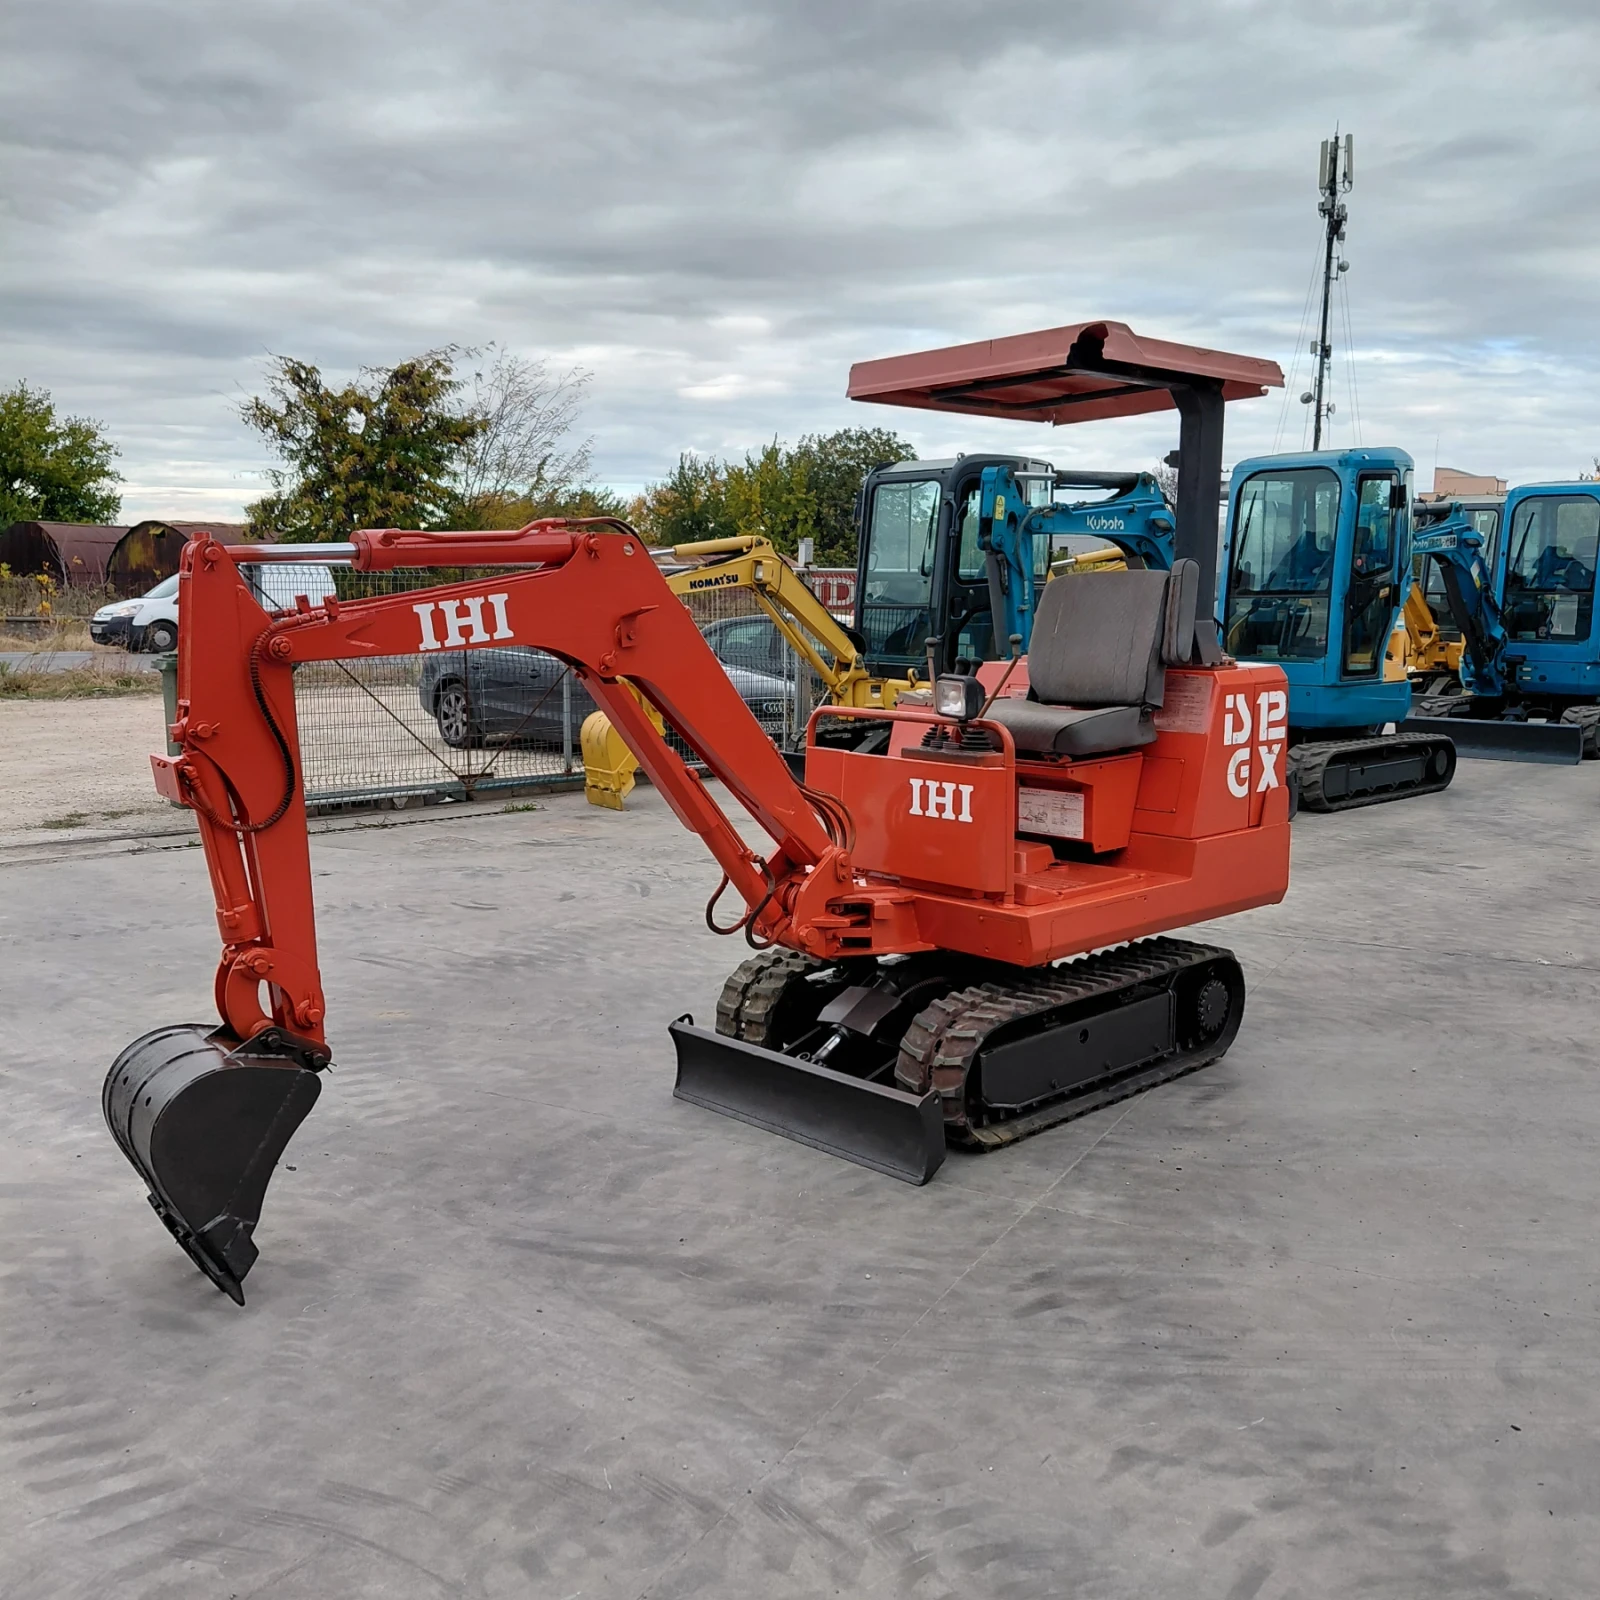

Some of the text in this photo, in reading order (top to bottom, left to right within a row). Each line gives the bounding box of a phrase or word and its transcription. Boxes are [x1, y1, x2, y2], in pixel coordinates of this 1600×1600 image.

[1086, 515, 1124, 530] Kubota
[689, 573, 739, 590] KOMATSU
[412, 592, 515, 651] IHI
[1226, 743, 1282, 798] GX
[908, 777, 974, 823] IHI
